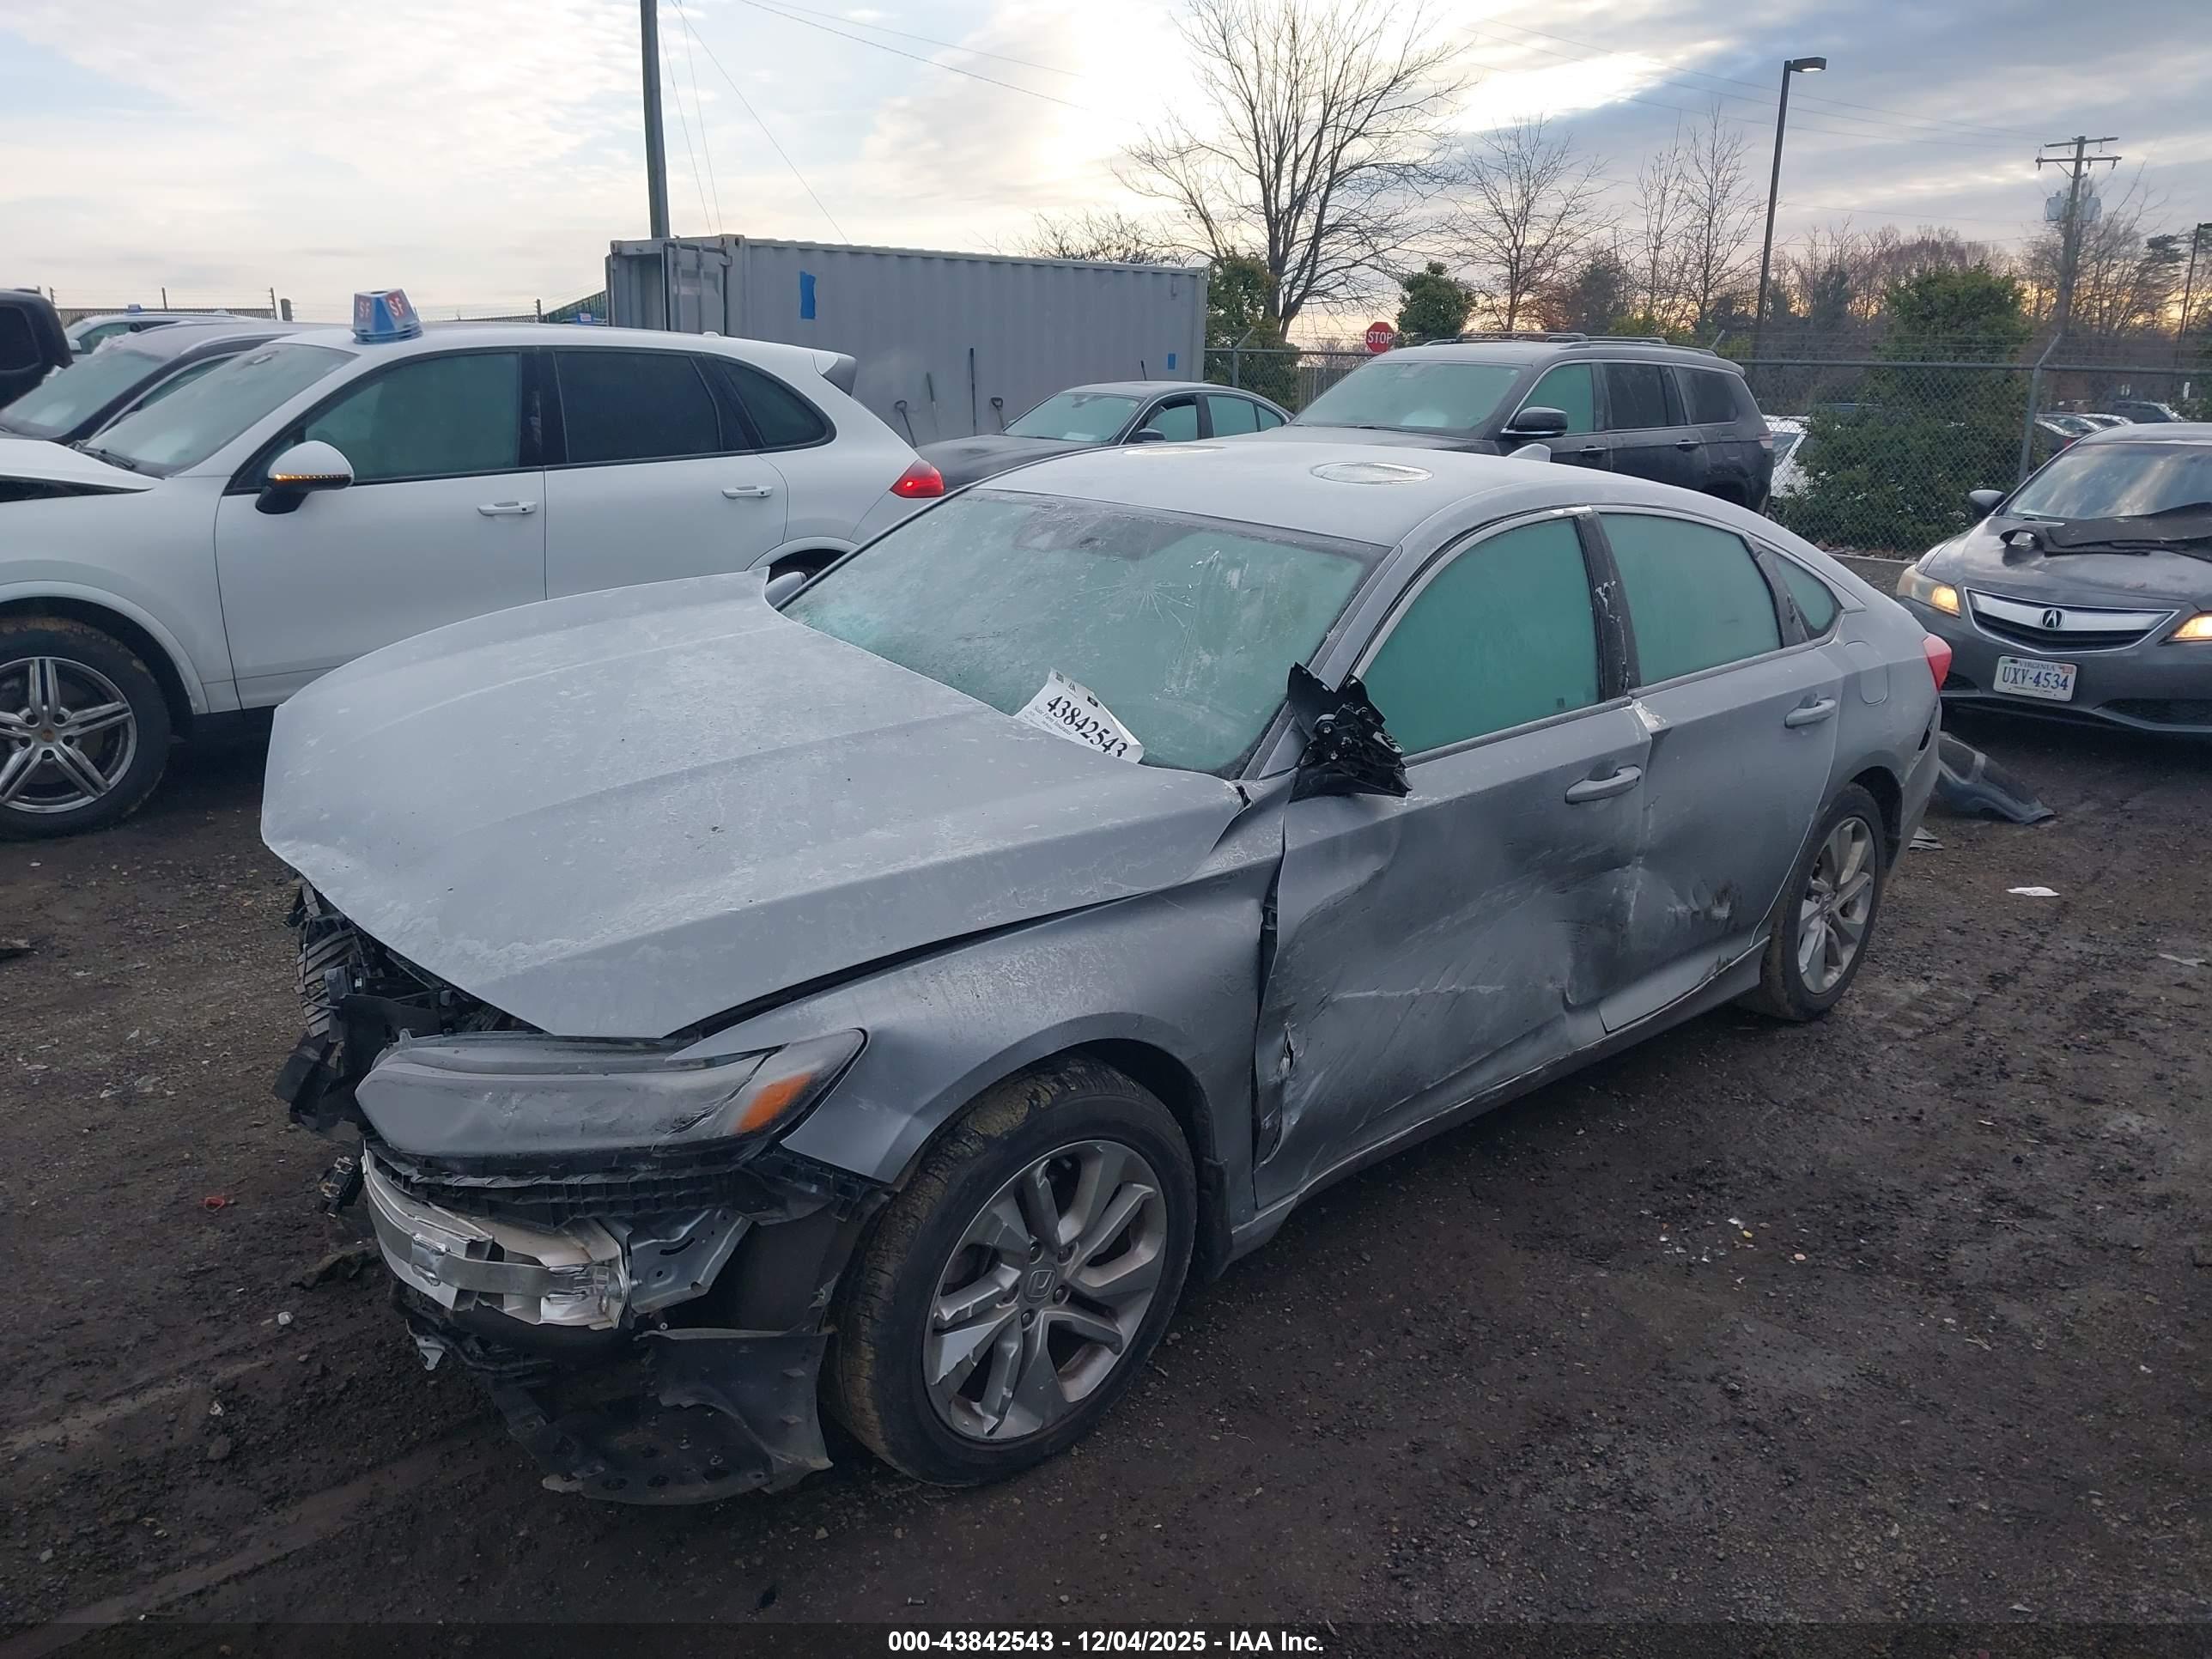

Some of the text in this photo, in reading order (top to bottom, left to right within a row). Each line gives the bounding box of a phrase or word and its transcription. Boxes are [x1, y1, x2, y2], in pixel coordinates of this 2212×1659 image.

[359, 301, 371, 318] SF
[389, 298, 404, 317] SF
[1367, 331, 1393, 344] STOP
[2019, 659, 2056, 671] VIRGINIA
[2002, 665, 2069, 690] UXY-4534
[1034, 704, 1045, 715] State
[1042, 711, 1054, 723] Farm
[1053, 720, 1073, 736] Insurance
[1047, 696, 1128, 757] 43842543
